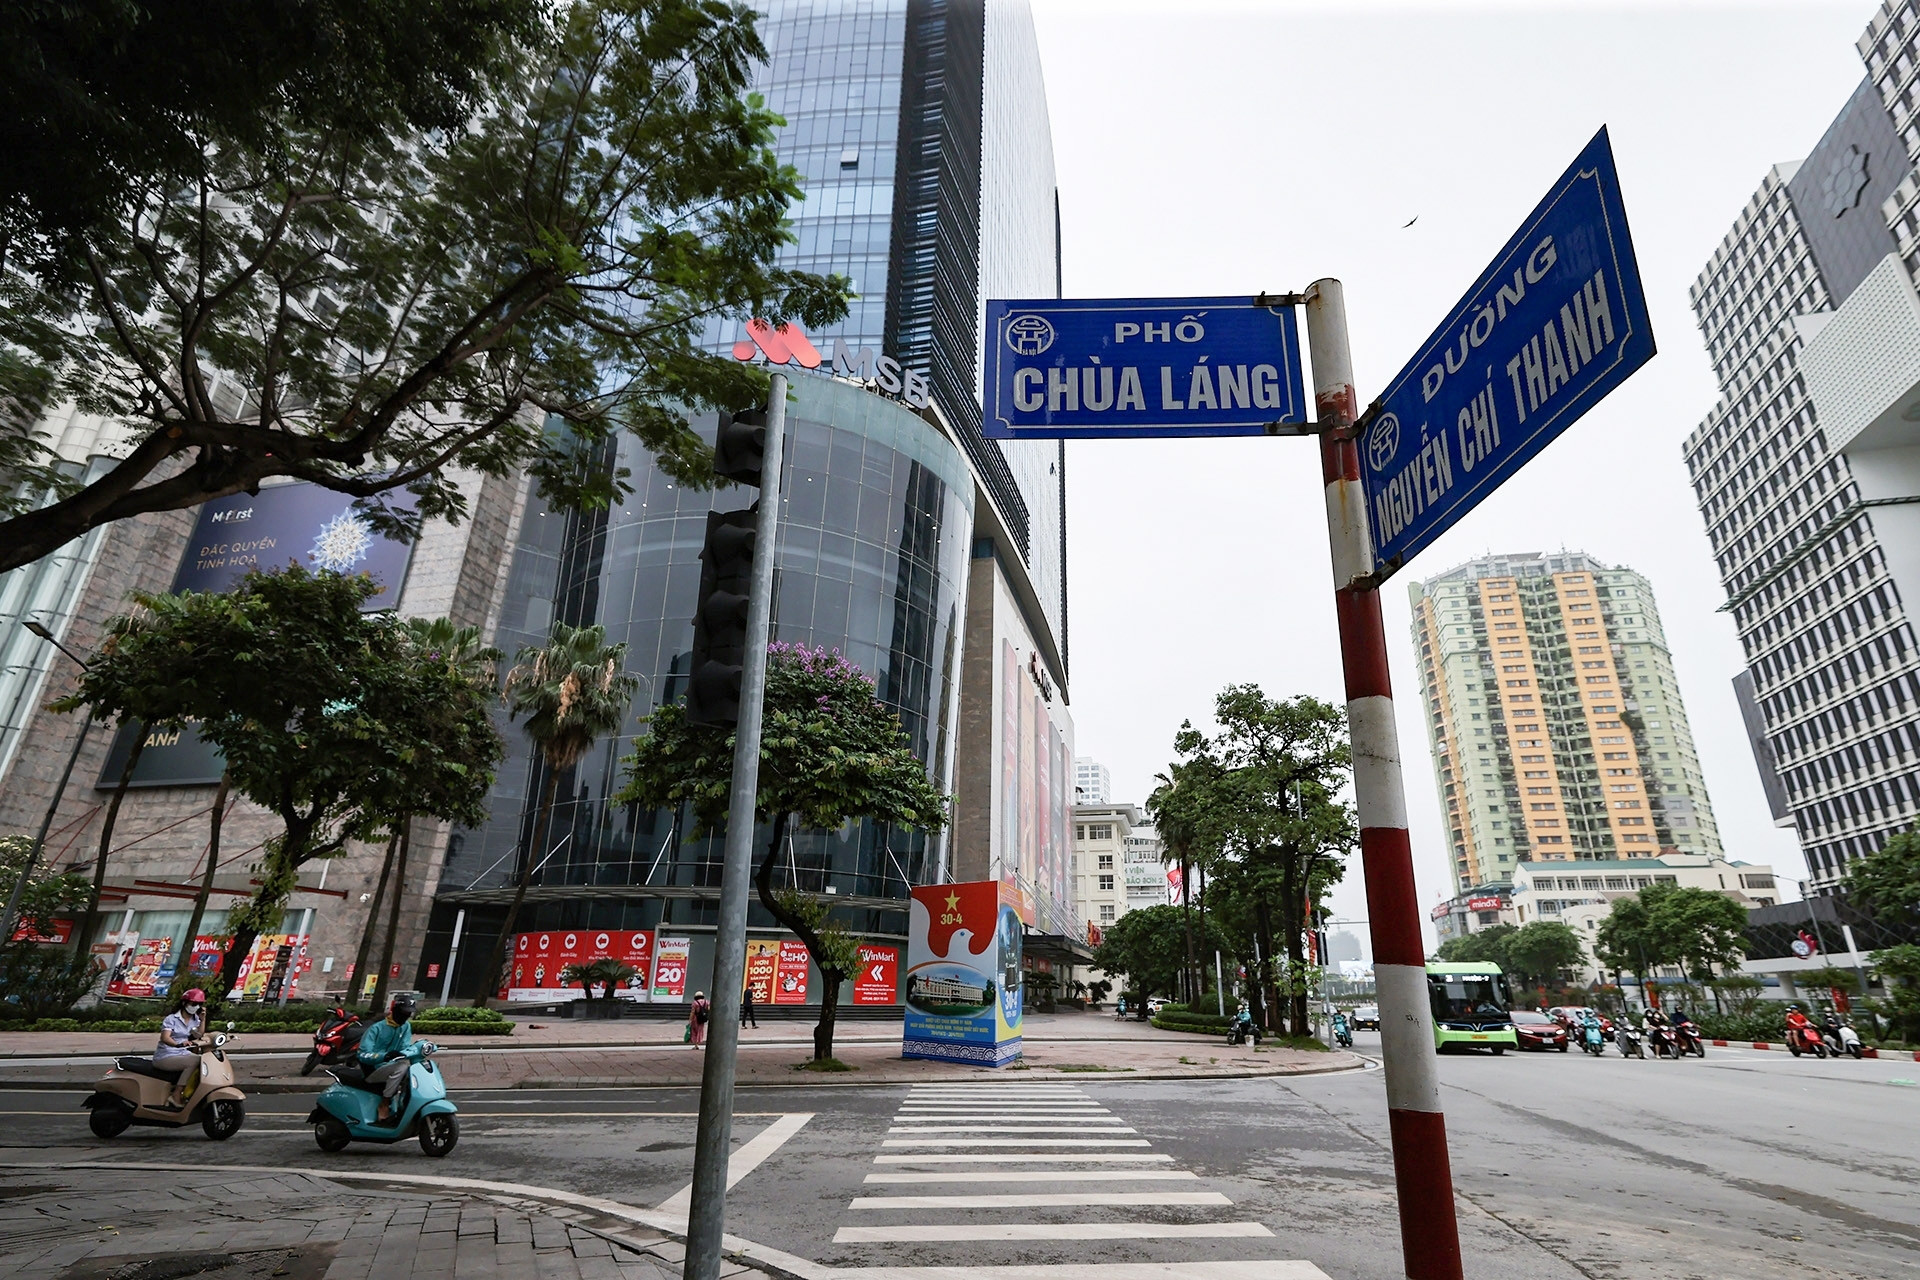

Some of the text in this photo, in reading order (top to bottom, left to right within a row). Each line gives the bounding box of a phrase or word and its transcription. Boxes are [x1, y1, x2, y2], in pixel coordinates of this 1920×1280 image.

[1115, 312, 1208, 344] PHỐ
[1421, 235, 1558, 405] ĐƯỜNG
[832, 337, 930, 410] MSB
[1013, 356, 1281, 412] CHÙA LÁNG
[1375, 269, 1615, 548] NGUYỄN CHÍ THANH
[197, 558, 226, 571] TINH
[940, 913, 963, 925] 30-4
[660, 940, 690, 949] WinMart
[860, 949, 894, 962] WinMart
[749, 966, 773, 975] 1000
